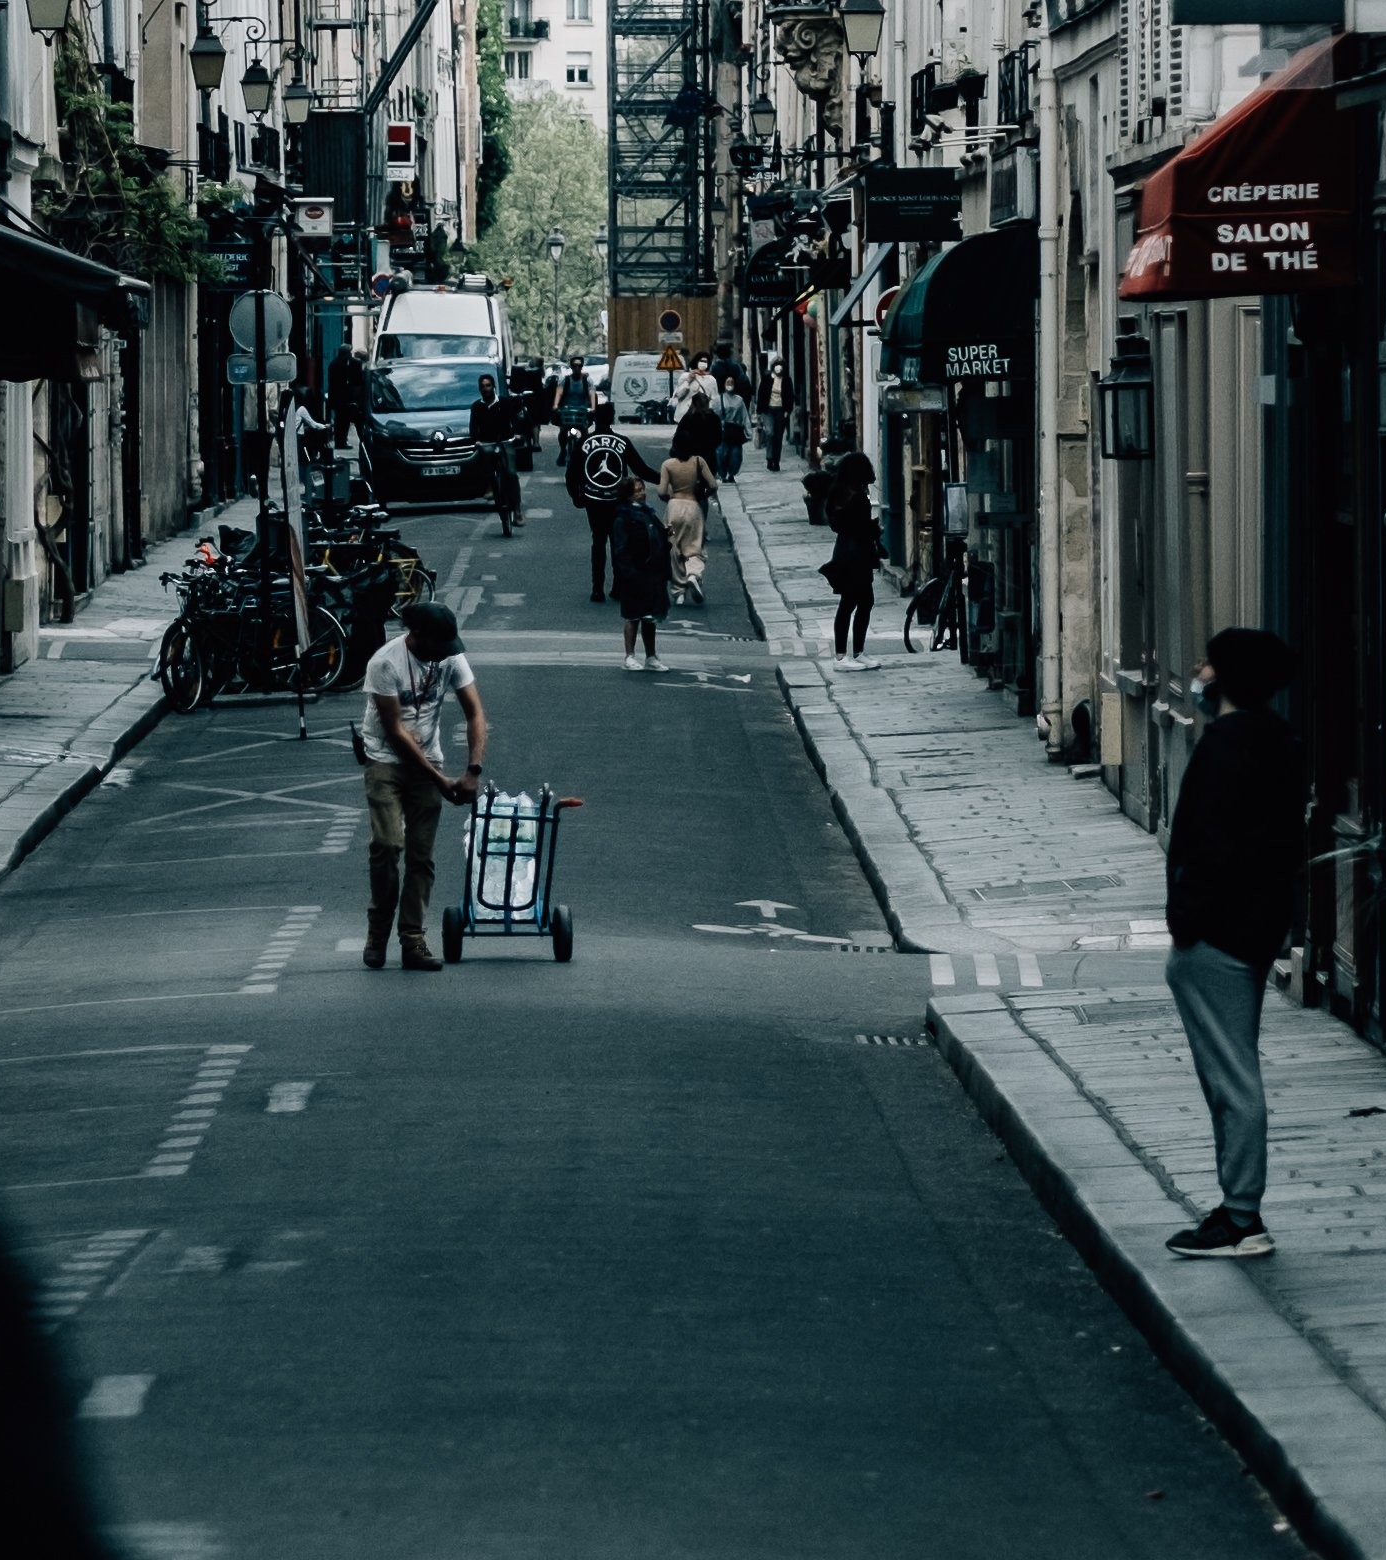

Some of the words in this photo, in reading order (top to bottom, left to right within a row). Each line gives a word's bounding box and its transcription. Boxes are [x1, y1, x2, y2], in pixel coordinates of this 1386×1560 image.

[1207, 182, 1320, 203] CRÊPERIE
[1217, 221, 1310, 243] SALON
[1211, 252, 1248, 271] DE
[1263, 242, 1319, 270] THÉ
[947, 344, 999, 362] SUPER
[945, 358, 1011, 378] MARKET
[581, 435, 627, 455] PARIS
